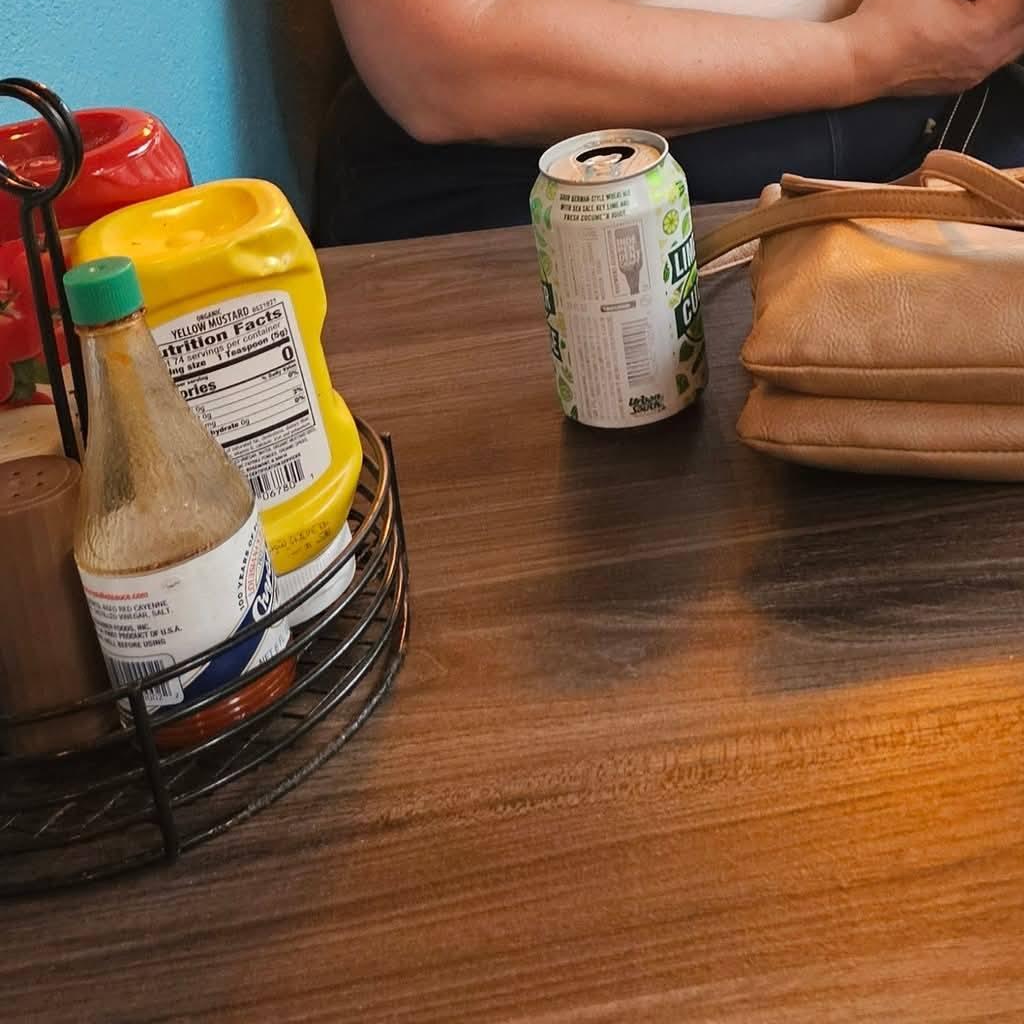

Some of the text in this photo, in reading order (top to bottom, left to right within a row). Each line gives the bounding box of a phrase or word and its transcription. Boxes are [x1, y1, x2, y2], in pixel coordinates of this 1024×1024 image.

[196, 307, 222, 322] ORGANIC
[233, 308, 283, 335] Facts
[171, 321, 207, 340] YELLOW
[208, 306, 249, 329] MUSTARD
[173, 356, 185, 366] 74
[187, 346, 225, 363] servings
[226, 339, 241, 352] per
[242, 321, 281, 343] container
[187, 360, 207, 372] size
[225, 337, 269, 359] Teaspoon
[270, 327, 289, 342] (5g)
[282, 345, 294, 361] 0
[187, 376, 209, 385] serving
[240, 418, 251, 427] 0g
[237, 549, 250, 587] YEARS
[133, 599, 168, 612] CAYENNE
[119, 631, 148, 640] PRODUCT
[150, 629, 158, 637] OF
[160, 624, 183, 636] U.S.A.
[143, 637, 166, 648] USING
